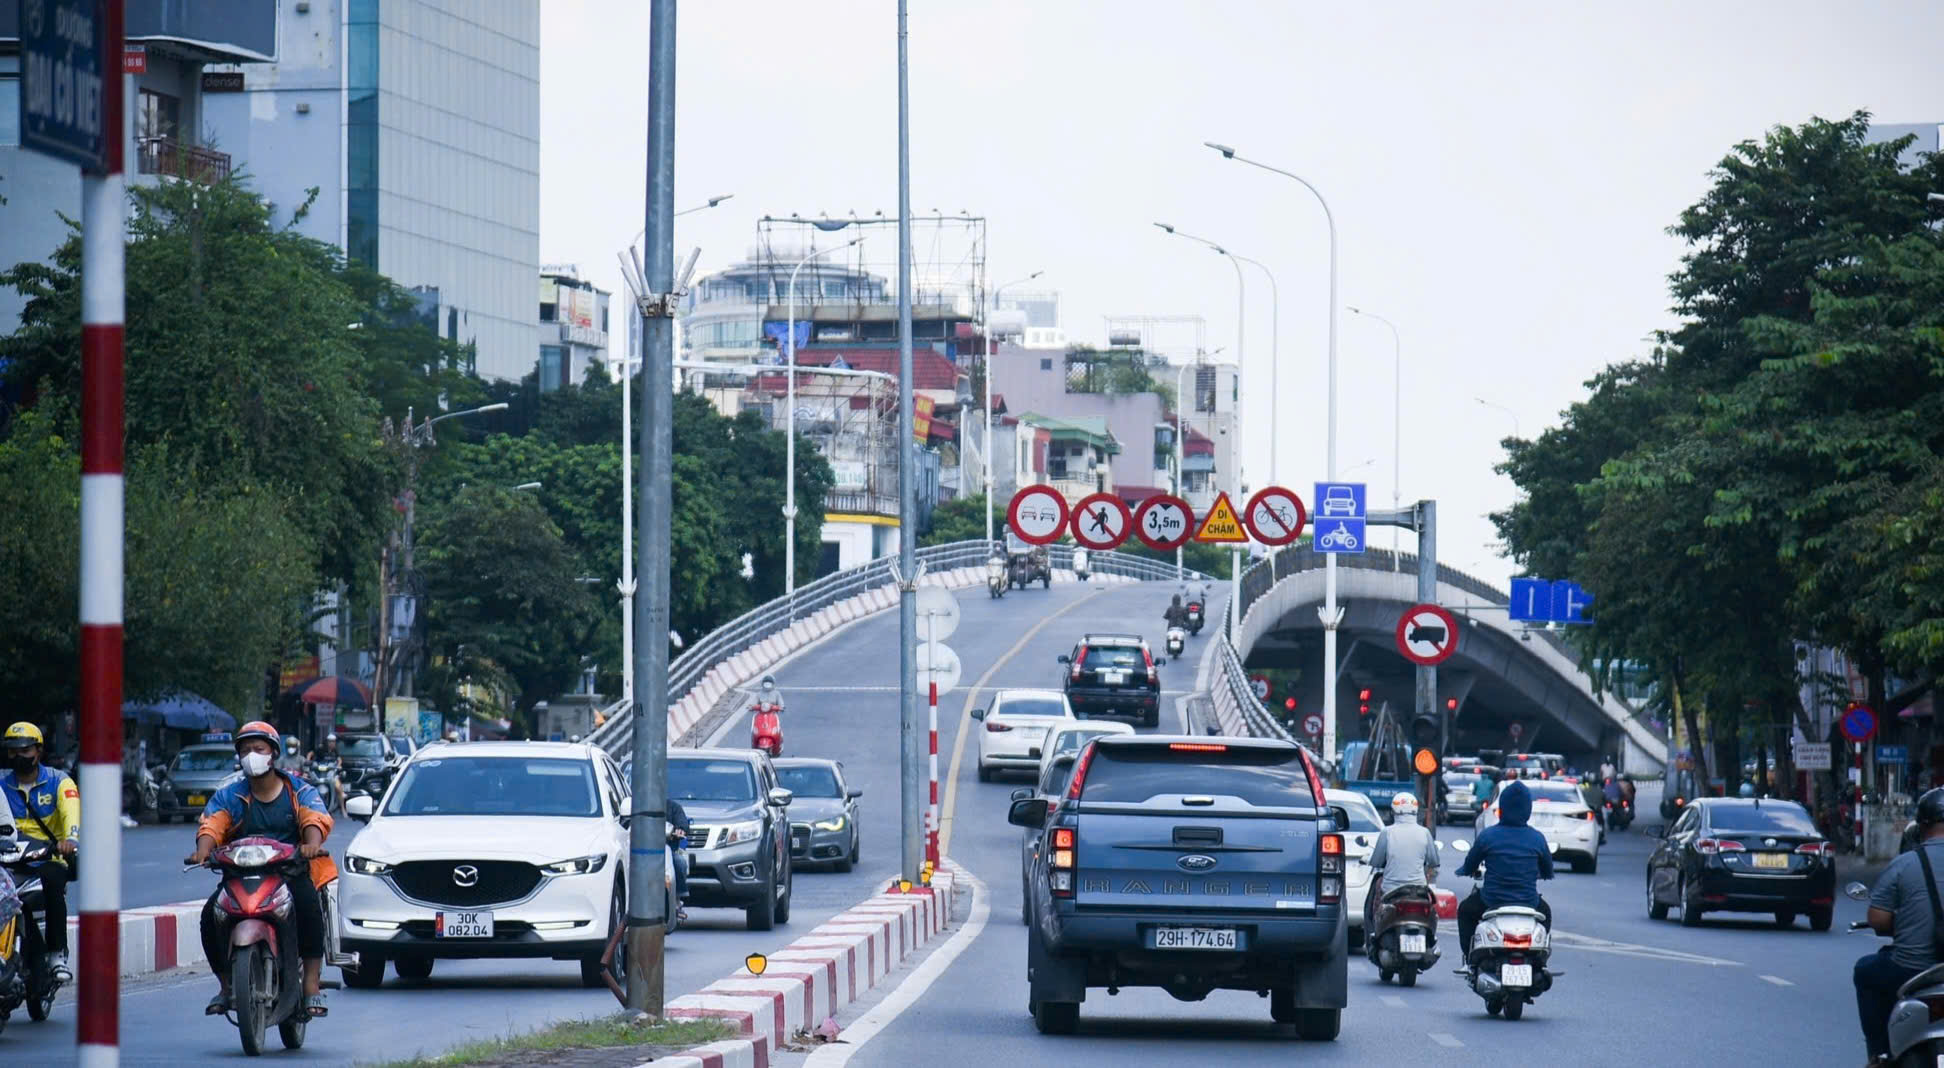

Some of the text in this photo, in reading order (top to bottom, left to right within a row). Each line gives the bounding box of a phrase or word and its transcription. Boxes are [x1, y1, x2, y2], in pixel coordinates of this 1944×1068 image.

[1148, 510, 1180, 533] 3,5m
[1084, 879, 1311, 898] RANGER
[457, 912, 479, 925] 30K
[448, 925, 488, 936] 082.04
